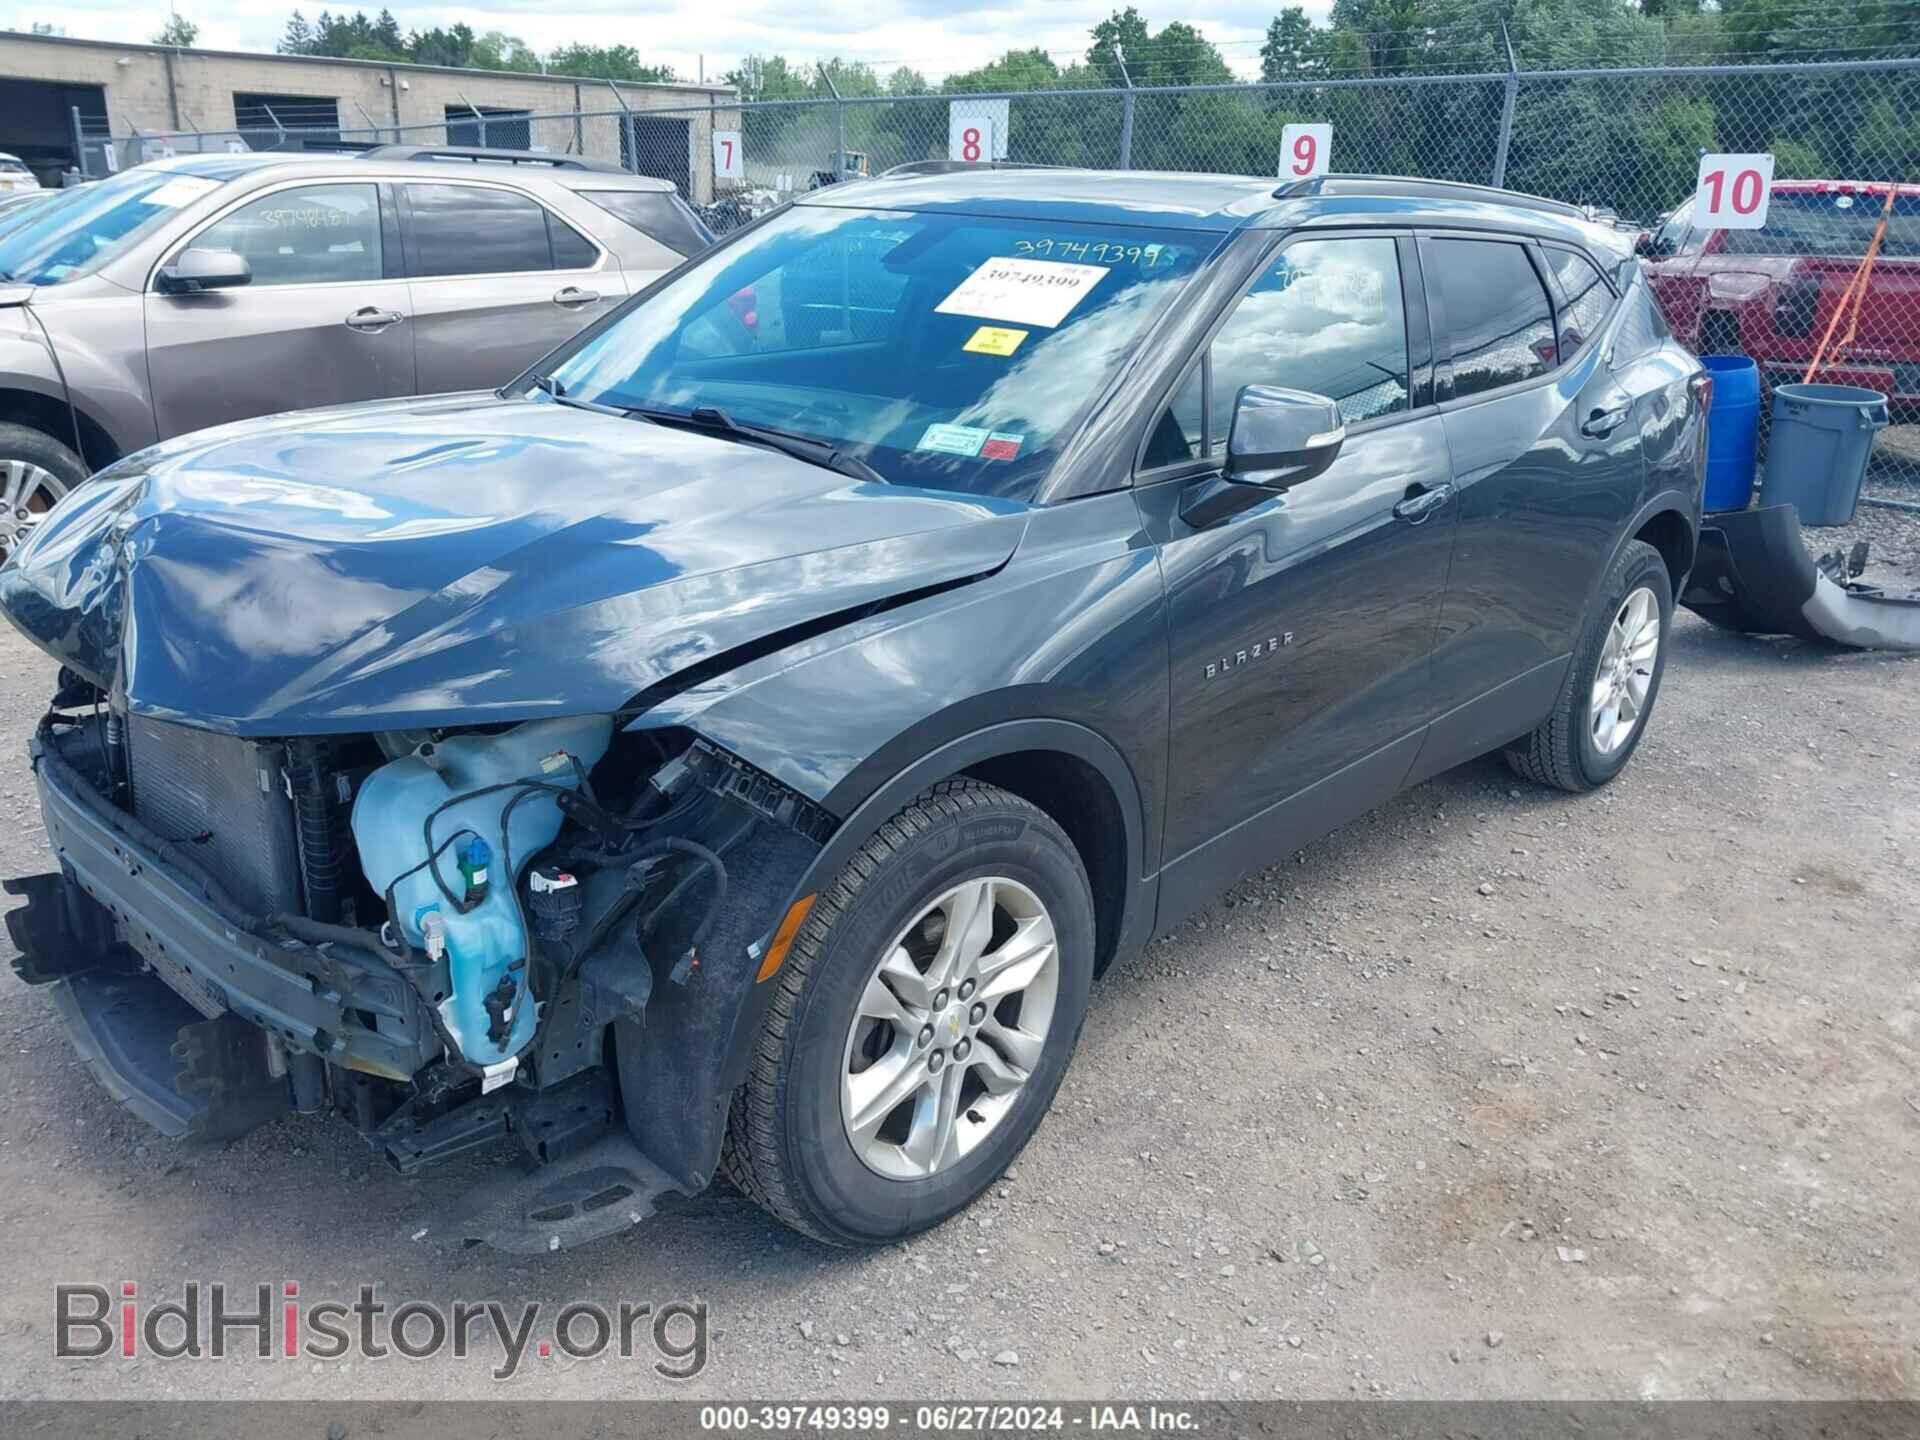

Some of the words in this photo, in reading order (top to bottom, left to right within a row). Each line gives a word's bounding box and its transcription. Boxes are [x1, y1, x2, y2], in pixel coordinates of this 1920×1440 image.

[721, 141, 733, 170] 7
[962, 128, 981, 161] 8
[1293, 135, 1316, 175] 9
[1703, 169, 1763, 215] 10
[1015, 239, 1161, 267] 39749399
[1204, 631, 1295, 680] BLAZER
